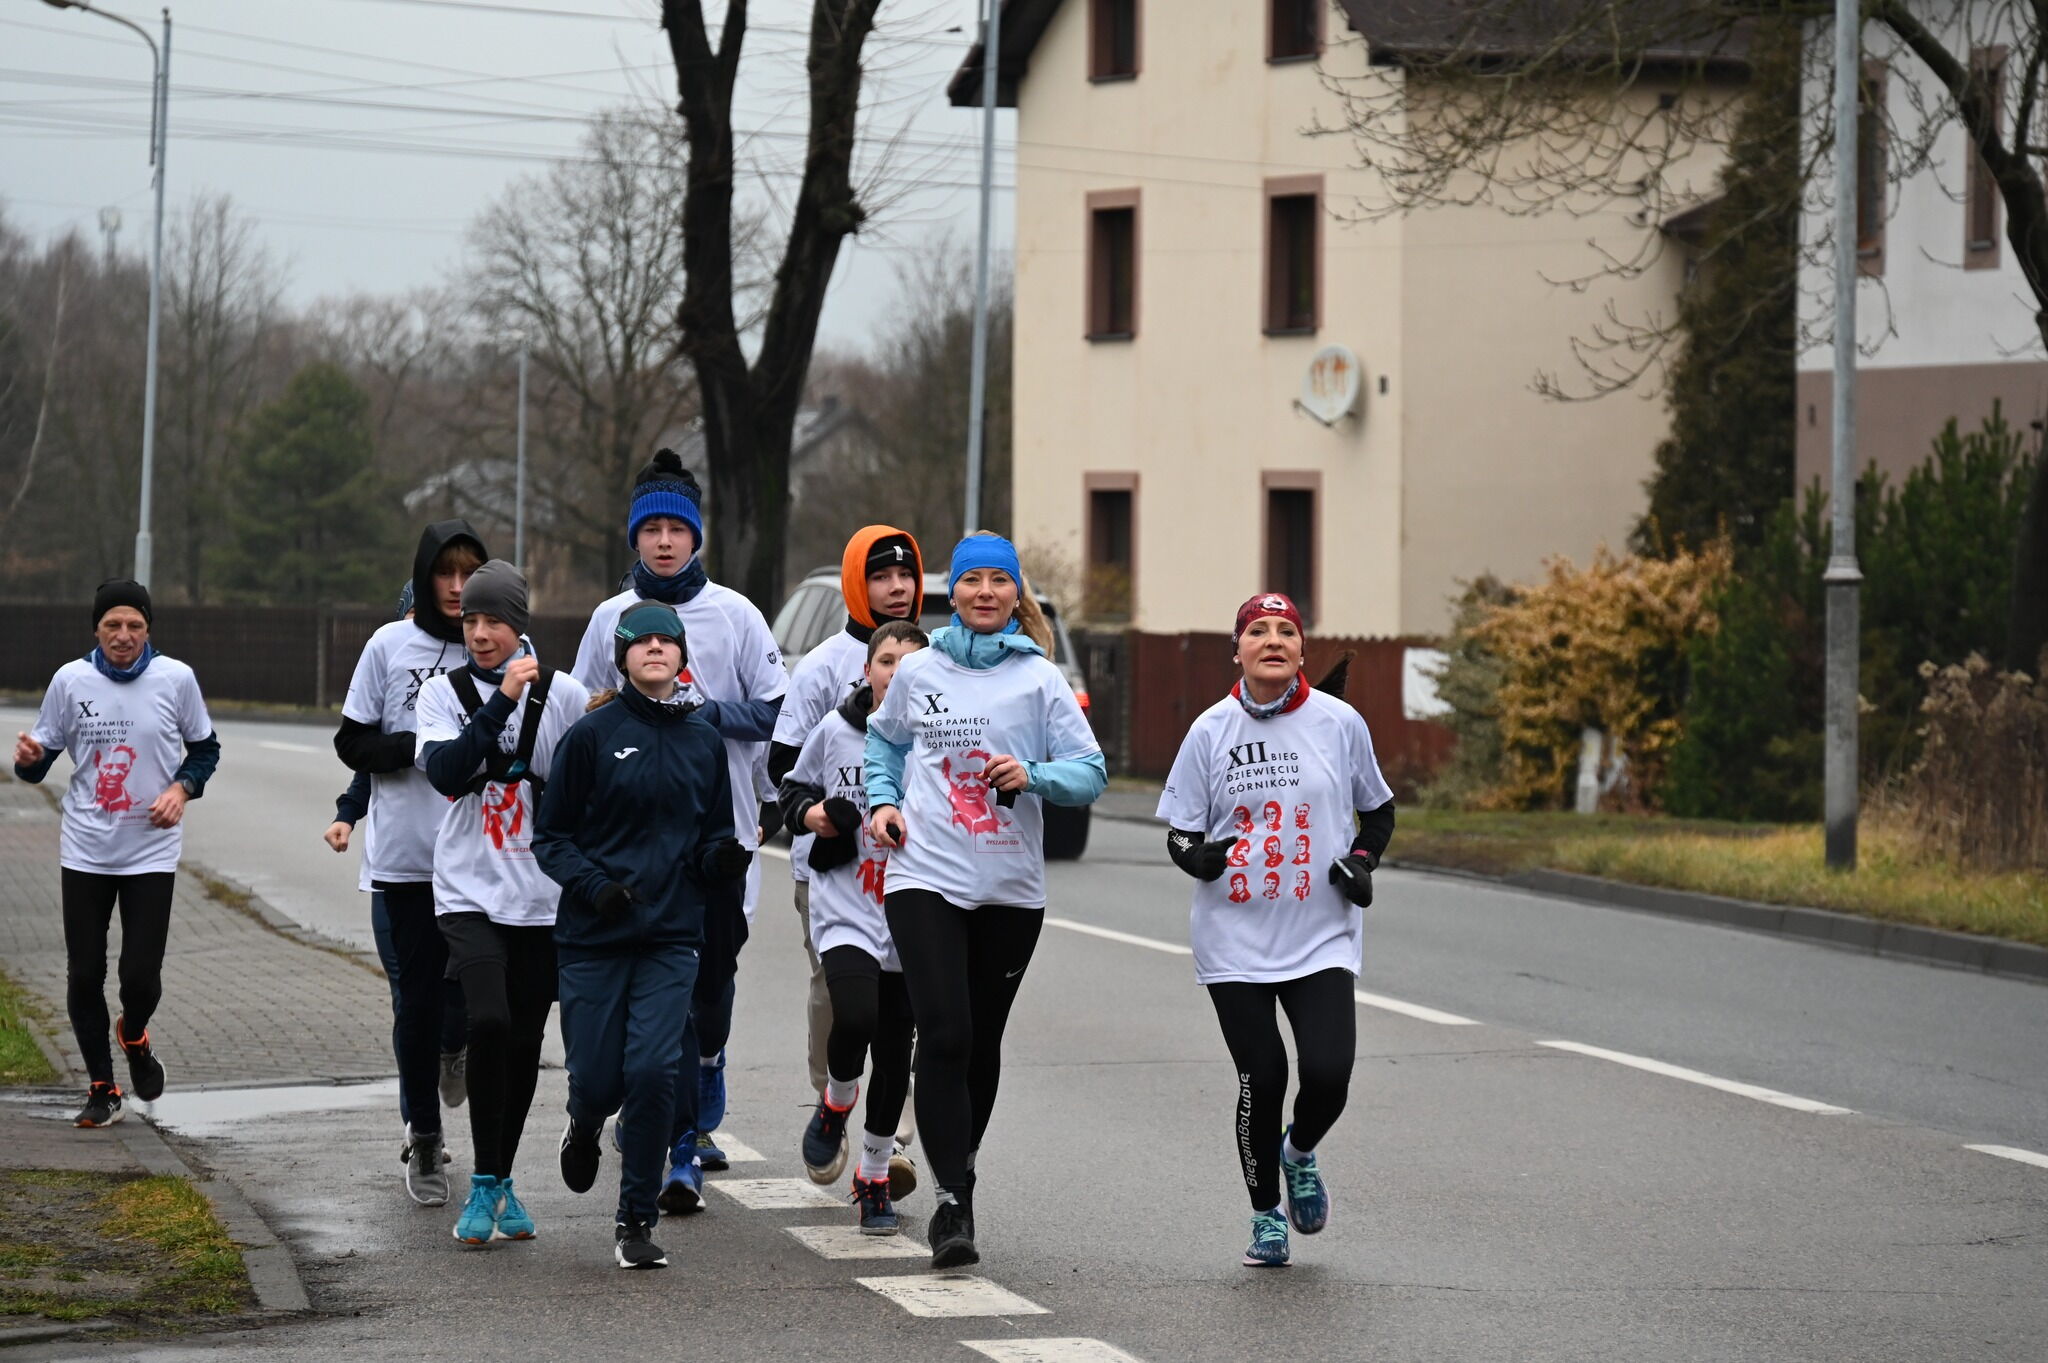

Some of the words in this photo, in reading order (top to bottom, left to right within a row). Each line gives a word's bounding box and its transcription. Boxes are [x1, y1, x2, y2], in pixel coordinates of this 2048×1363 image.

[77, 700, 99, 719] X.
[923, 693, 949, 716] X.
[946, 717, 990, 726] PAMIĘCI
[924, 728, 982, 738] DZIEWIĘCIU
[928, 738, 982, 749] GÓRNIKÓW
[1227, 741, 1269, 771] XII
[1271, 752, 1298, 761] BIEG
[1226, 765, 1299, 782] DZIEWIĘCIU
[1228, 777, 1300, 795] GÓRNIKÓW
